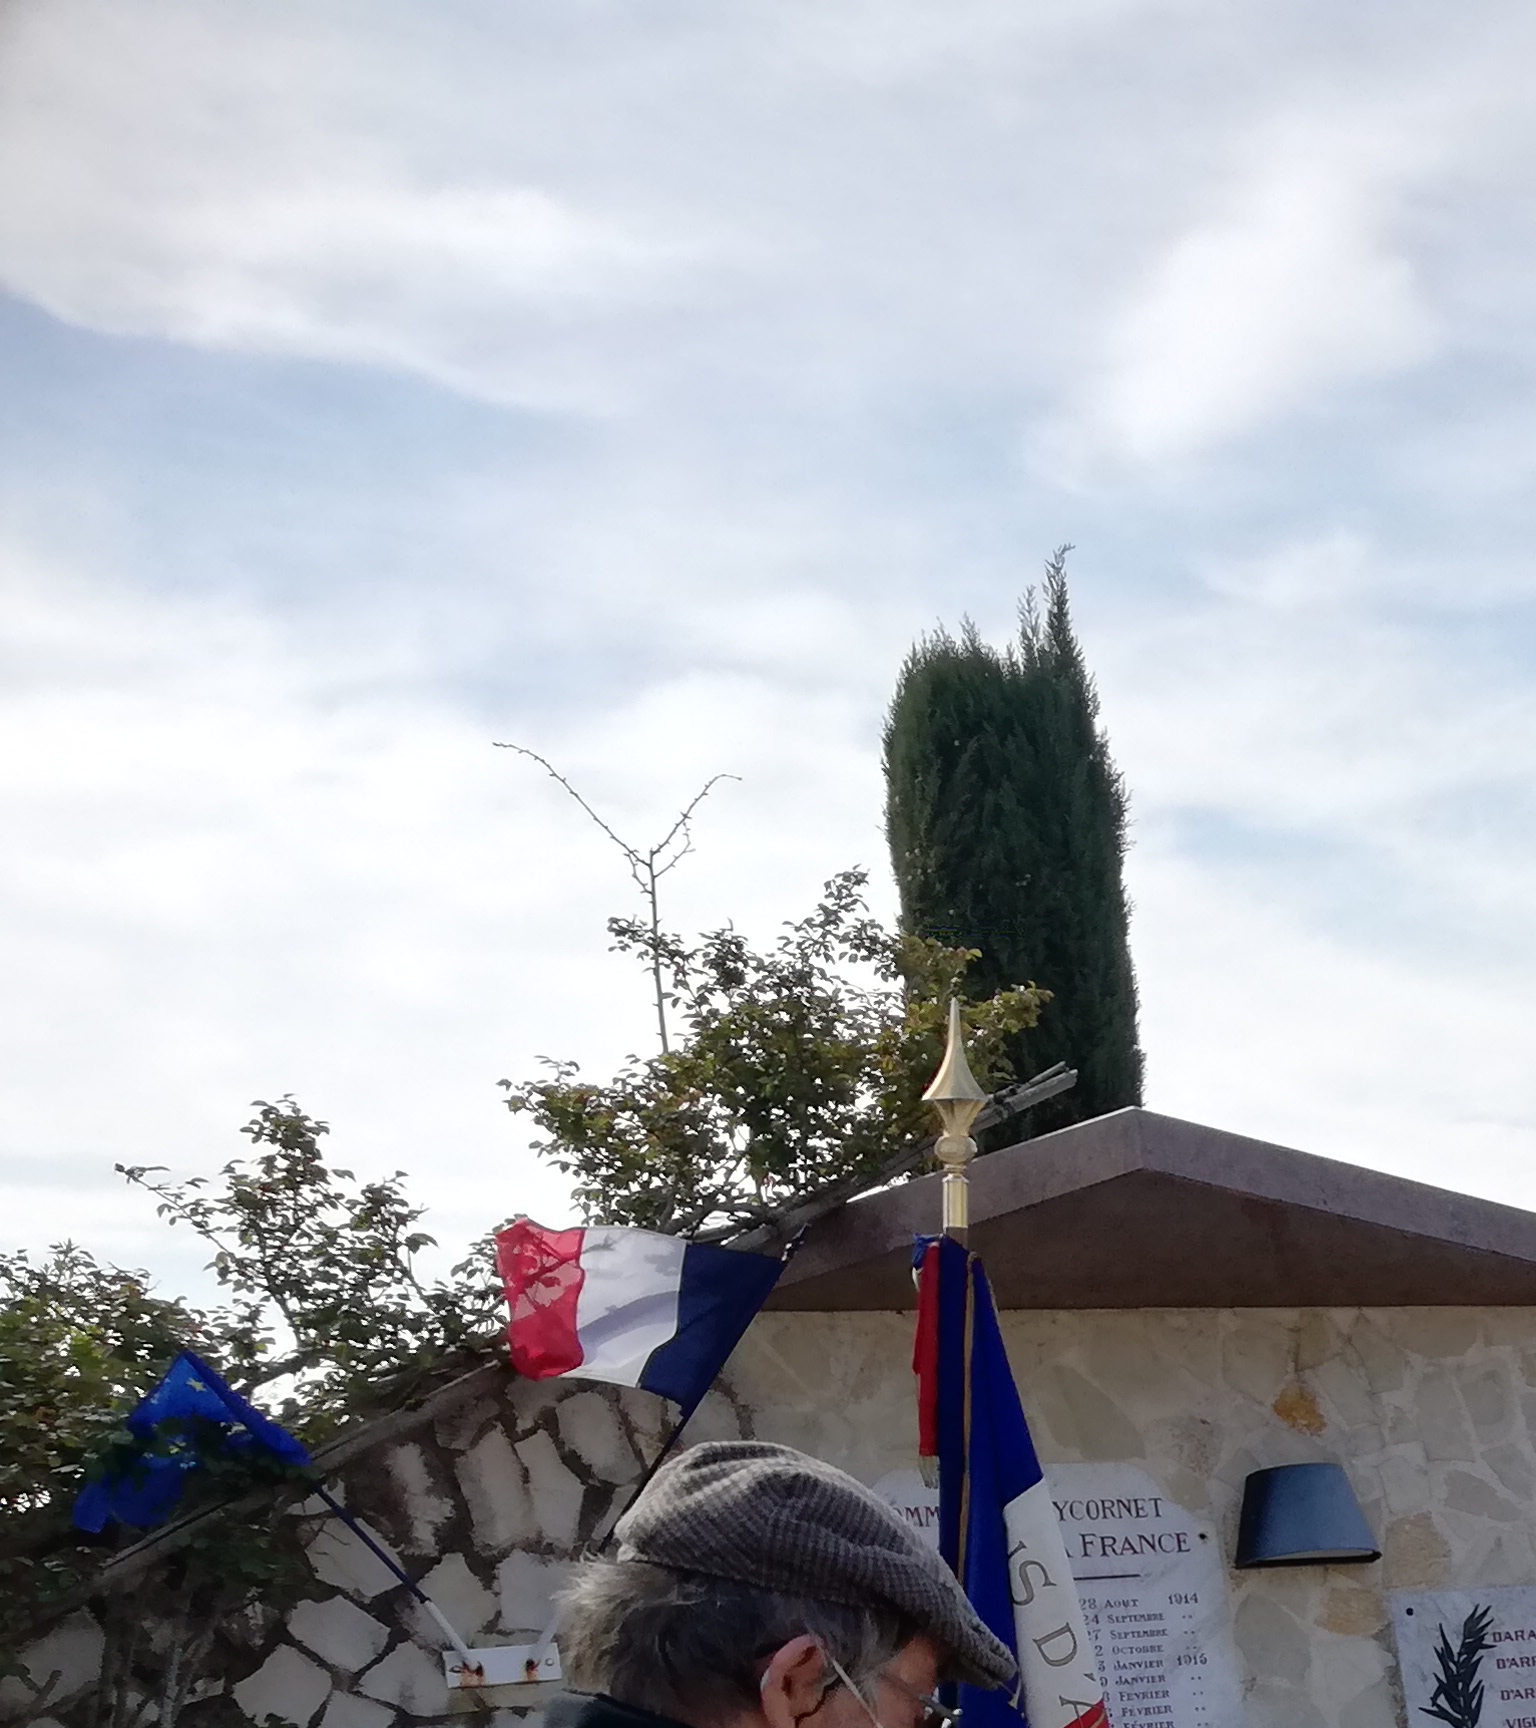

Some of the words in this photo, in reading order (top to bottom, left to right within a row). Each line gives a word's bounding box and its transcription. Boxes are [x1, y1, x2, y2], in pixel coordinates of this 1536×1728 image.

[1052, 1497, 1164, 1522] YCORNET
[1079, 1531, 1192, 1558] FRANCE
[1168, 1592, 1199, 1606] 1914
[1107, 1612, 1166, 1625] SEPTEMBRE
[1110, 1628, 1169, 1641] SEPTEMBRE
[1112, 1644, 1166, 1655] OCTOBRE
[1113, 1658, 1165, 1672] JANVIER
[1176, 1652, 1208, 1667] 1915
[1115, 1674, 1167, 1687] JANVIER
